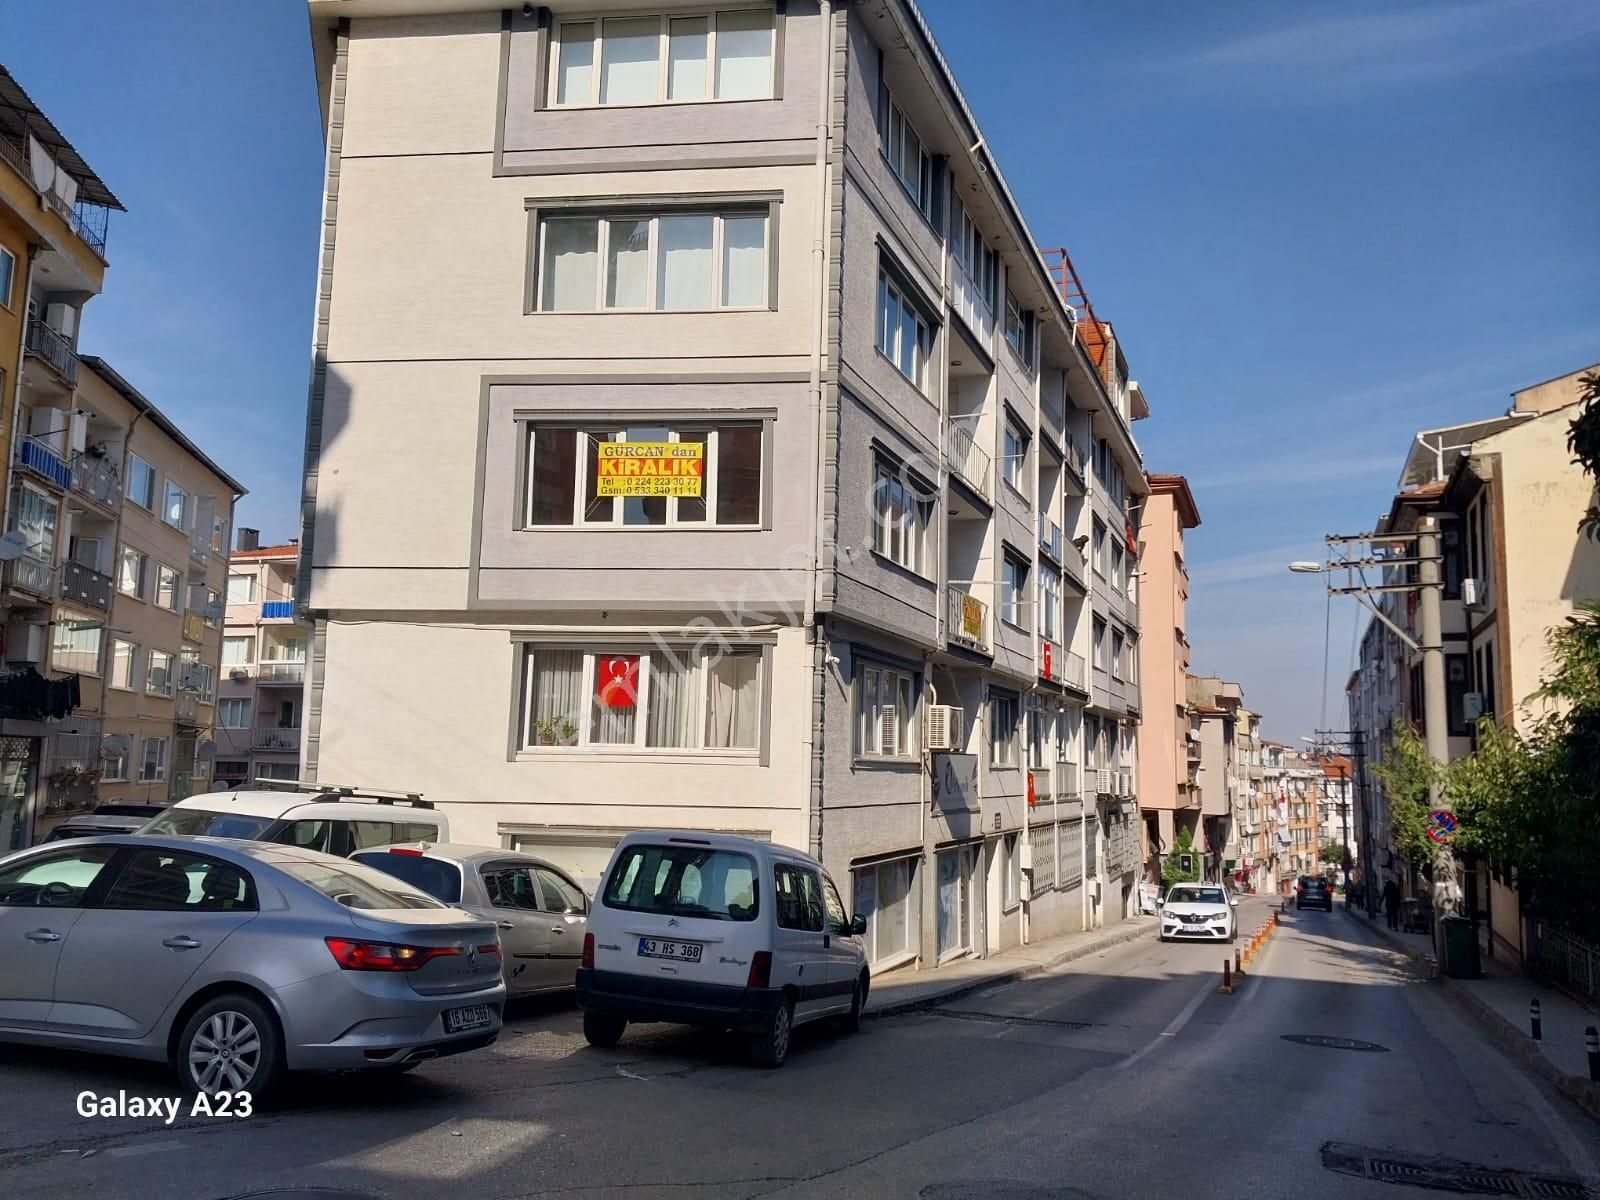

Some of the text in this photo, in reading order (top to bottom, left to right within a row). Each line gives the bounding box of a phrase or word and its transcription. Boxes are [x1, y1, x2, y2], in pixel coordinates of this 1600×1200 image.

[671, 446, 697, 457] dan
[602, 477, 614, 486] Tel
[635, 477, 651, 486] 224
[654, 477, 671, 486] 223
[673, 477, 684, 486] 30
[687, 477, 698, 486] 77
[634, 486, 651, 495] 533
[654, 486, 671, 495] 340
[674, 486, 683, 495] 11
[688, 486, 697, 495] 11
[644, 940, 700, 957] 43 HS 368
[451, 1009, 460, 1025] 16
